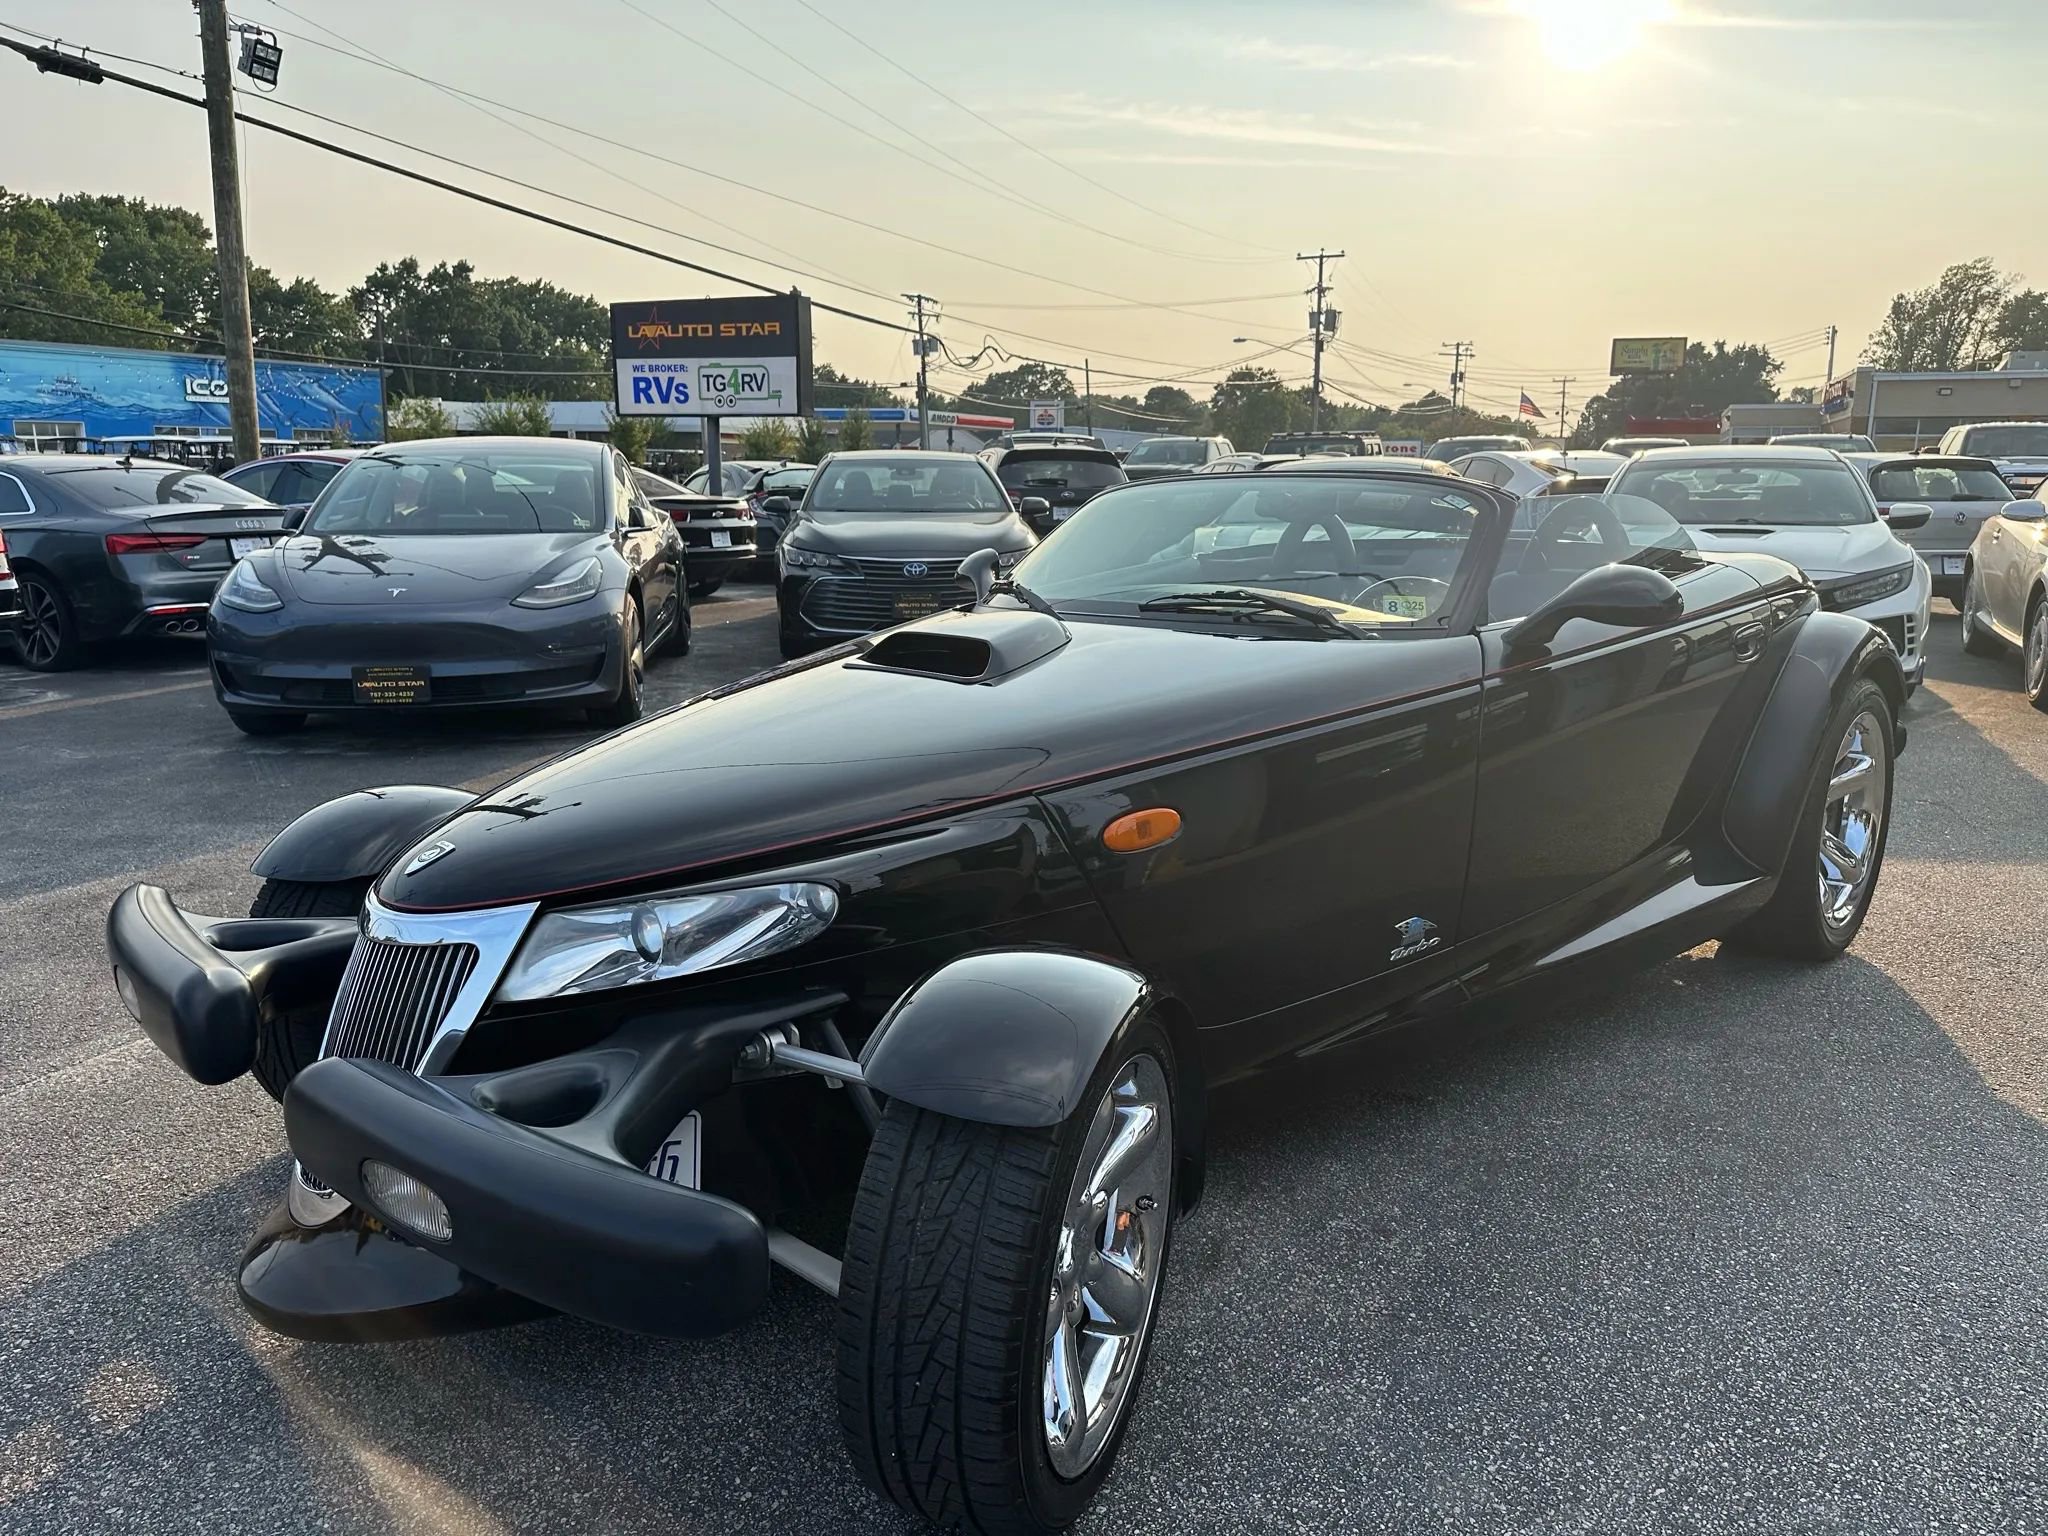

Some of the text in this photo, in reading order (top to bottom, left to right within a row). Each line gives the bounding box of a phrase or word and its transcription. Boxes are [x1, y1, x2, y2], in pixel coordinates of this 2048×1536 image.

[720, 322, 780, 337] STAR
[632, 363, 688, 373] WE BROKER:
[185, 377, 230, 396] ICO
[702, 368, 766, 395] TG4RV
[632, 376, 689, 405] RVs
[930, 413, 956, 424] AMOCO
[1388, 600, 1398, 612] 8
